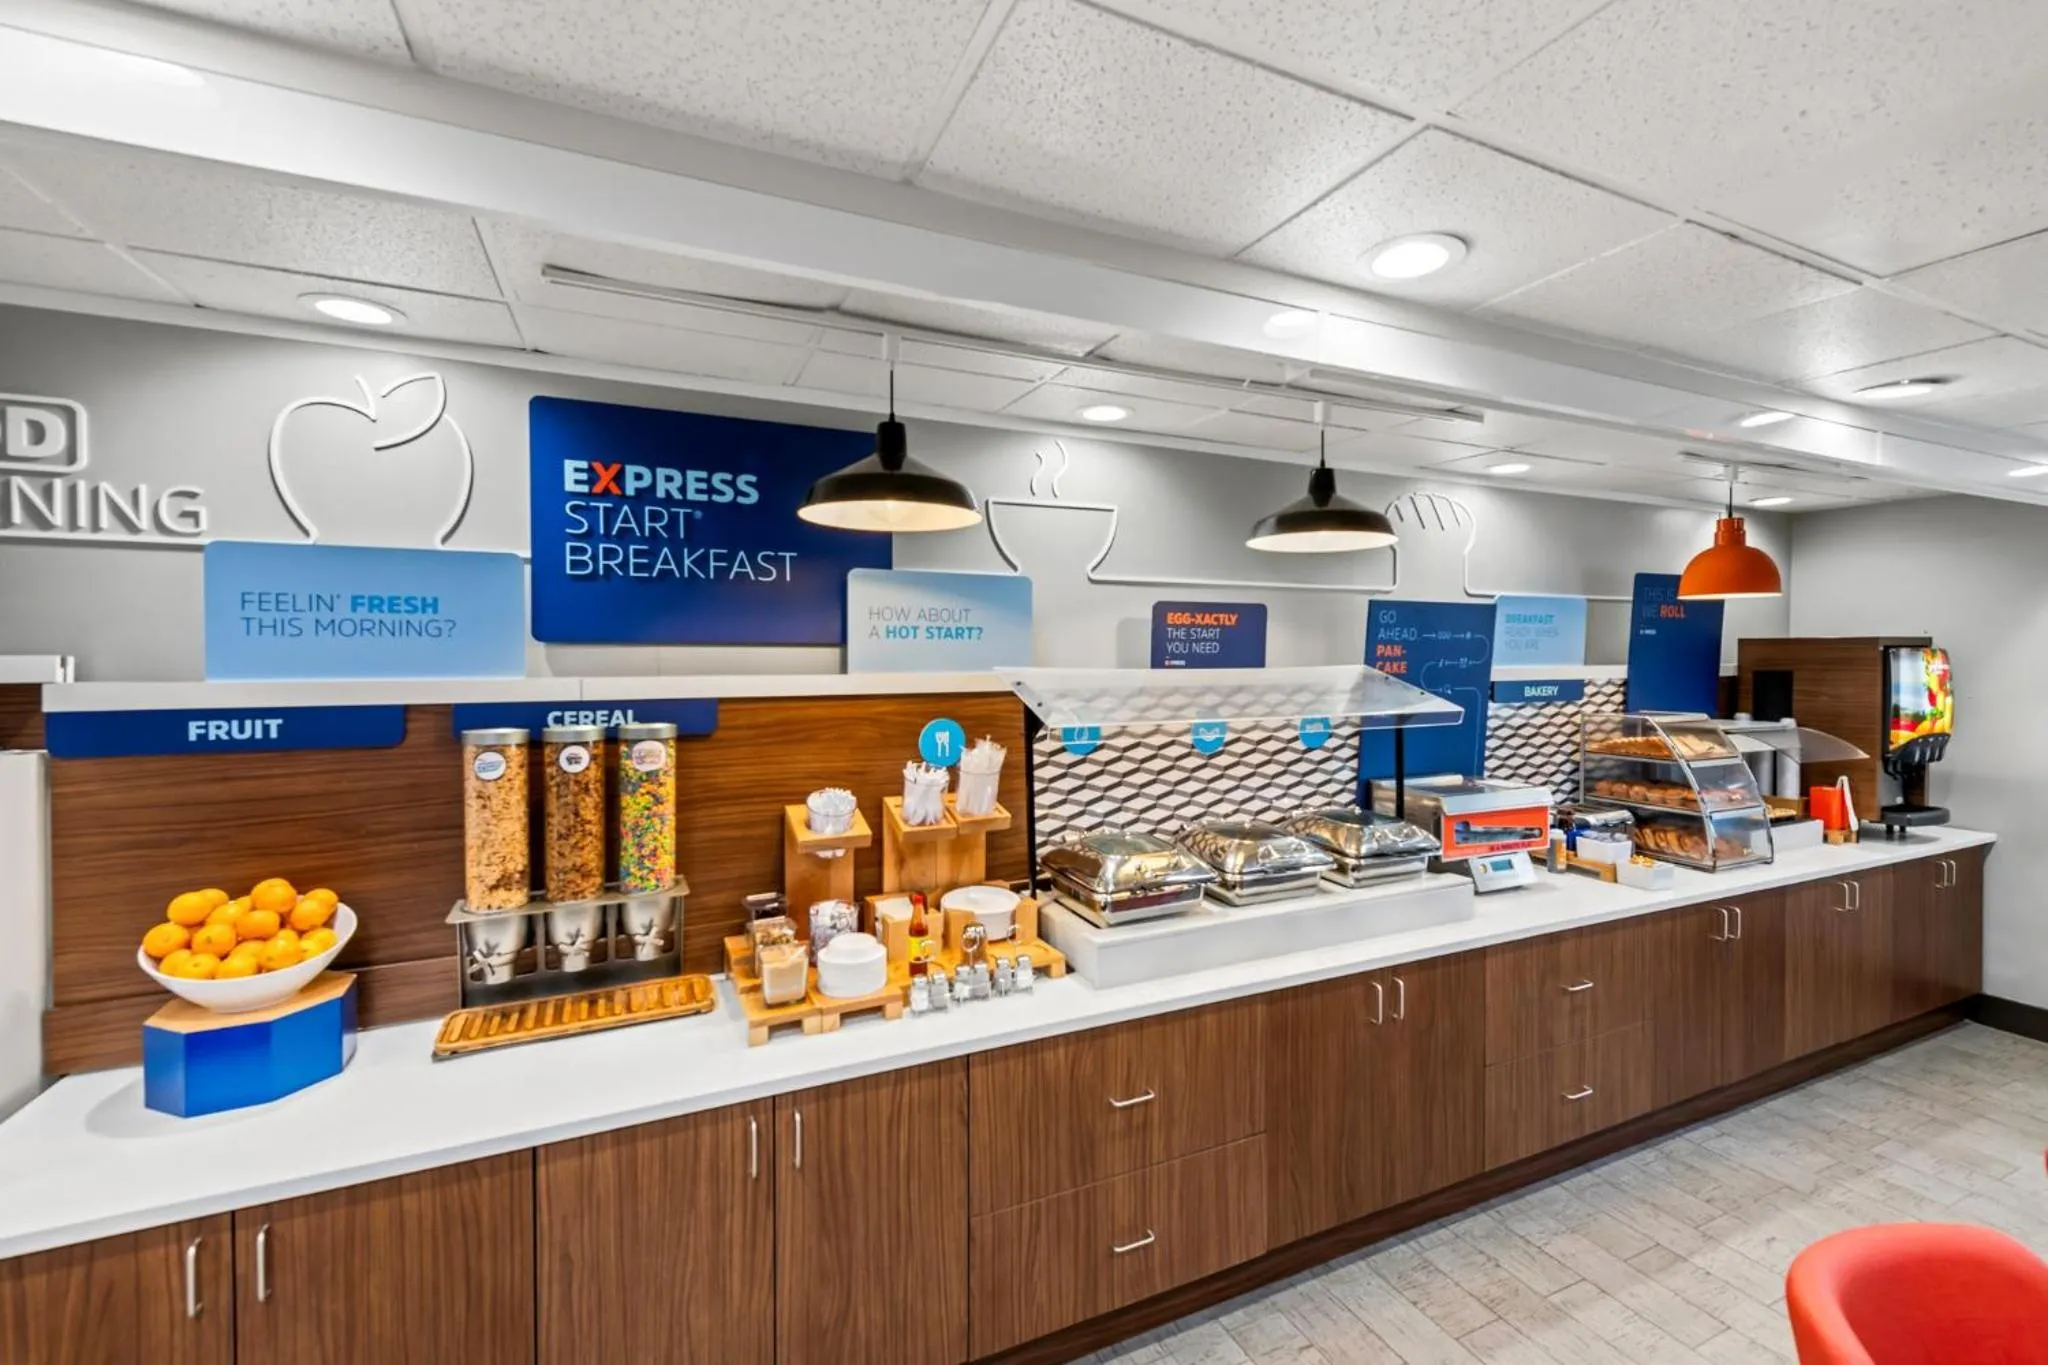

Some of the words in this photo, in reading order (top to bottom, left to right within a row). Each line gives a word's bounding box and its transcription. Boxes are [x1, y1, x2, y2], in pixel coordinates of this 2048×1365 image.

[0, 406, 67, 458] D
[564, 459, 759, 504] EXPRESS
[565, 542, 797, 581] BREAKFAST
[240, 592, 340, 613] FEELIN'
[350, 595, 439, 614] FRESH
[868, 607, 911, 621] HOW
[918, 608, 971, 623] ABOUT
[1379, 610, 1397, 624] GO
[1660, 604, 1685, 618] ROLL
[1167, 612, 1238, 626] EGG-XACTLY
[240, 617, 303, 637] THIS
[314, 618, 457, 638] MORNING?
[868, 625, 880, 640] A
[885, 625, 919, 640] HOT
[925, 626, 984, 641] START?
[1167, 627, 1187, 640] THE
[1190, 628, 1220, 640] START
[1378, 627, 1418, 641] AHEAD
[1166, 642, 1189, 654] YOU
[1191, 642, 1220, 654] NEED
[1376, 644, 1407, 657] PAN-
[1375, 661, 1408, 674] CAKE
[1524, 685, 1559, 697] BAKERY
[547, 709, 641, 728] CEREAL
[188, 718, 284, 742] FRUIT
